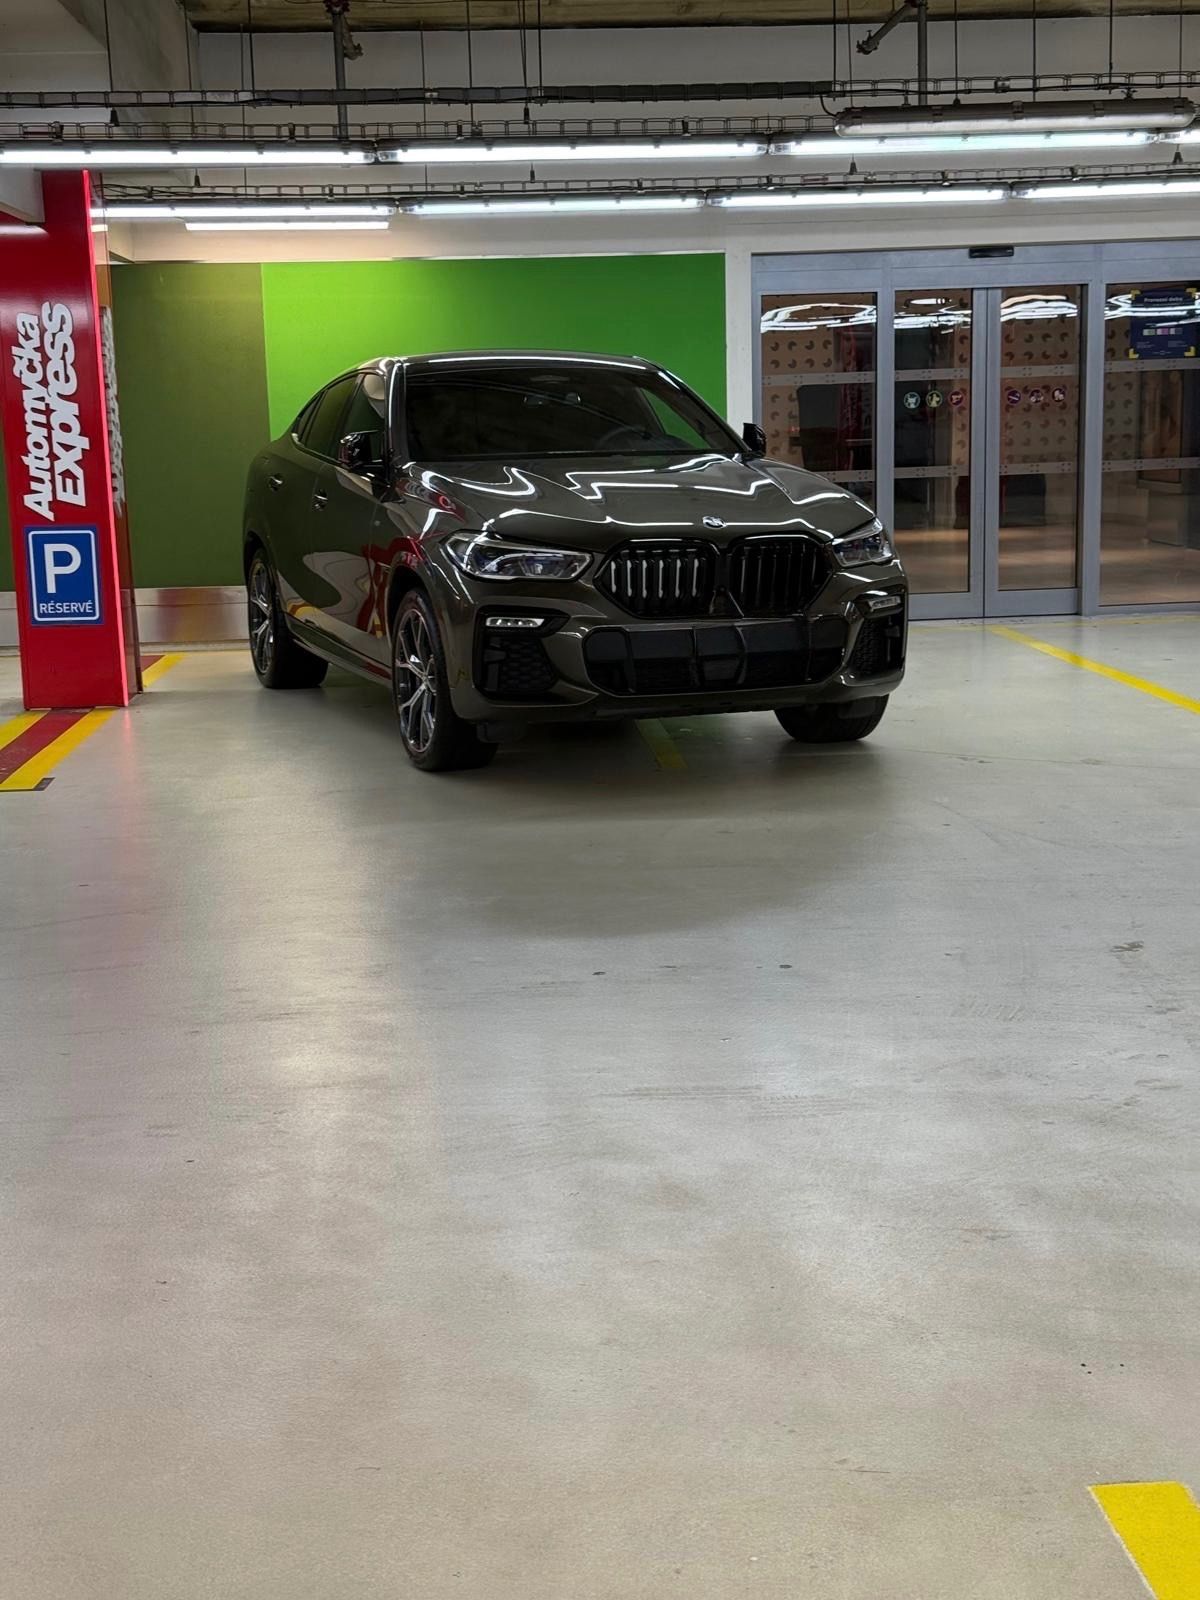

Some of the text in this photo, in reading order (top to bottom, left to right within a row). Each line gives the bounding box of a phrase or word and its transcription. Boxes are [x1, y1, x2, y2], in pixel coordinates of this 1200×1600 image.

[11, 312, 55, 521] Automyčka
[41, 301, 90, 507] Express
[39, 600, 93, 613] RÉSERVÉ
[43, 543, 81, 593] P
